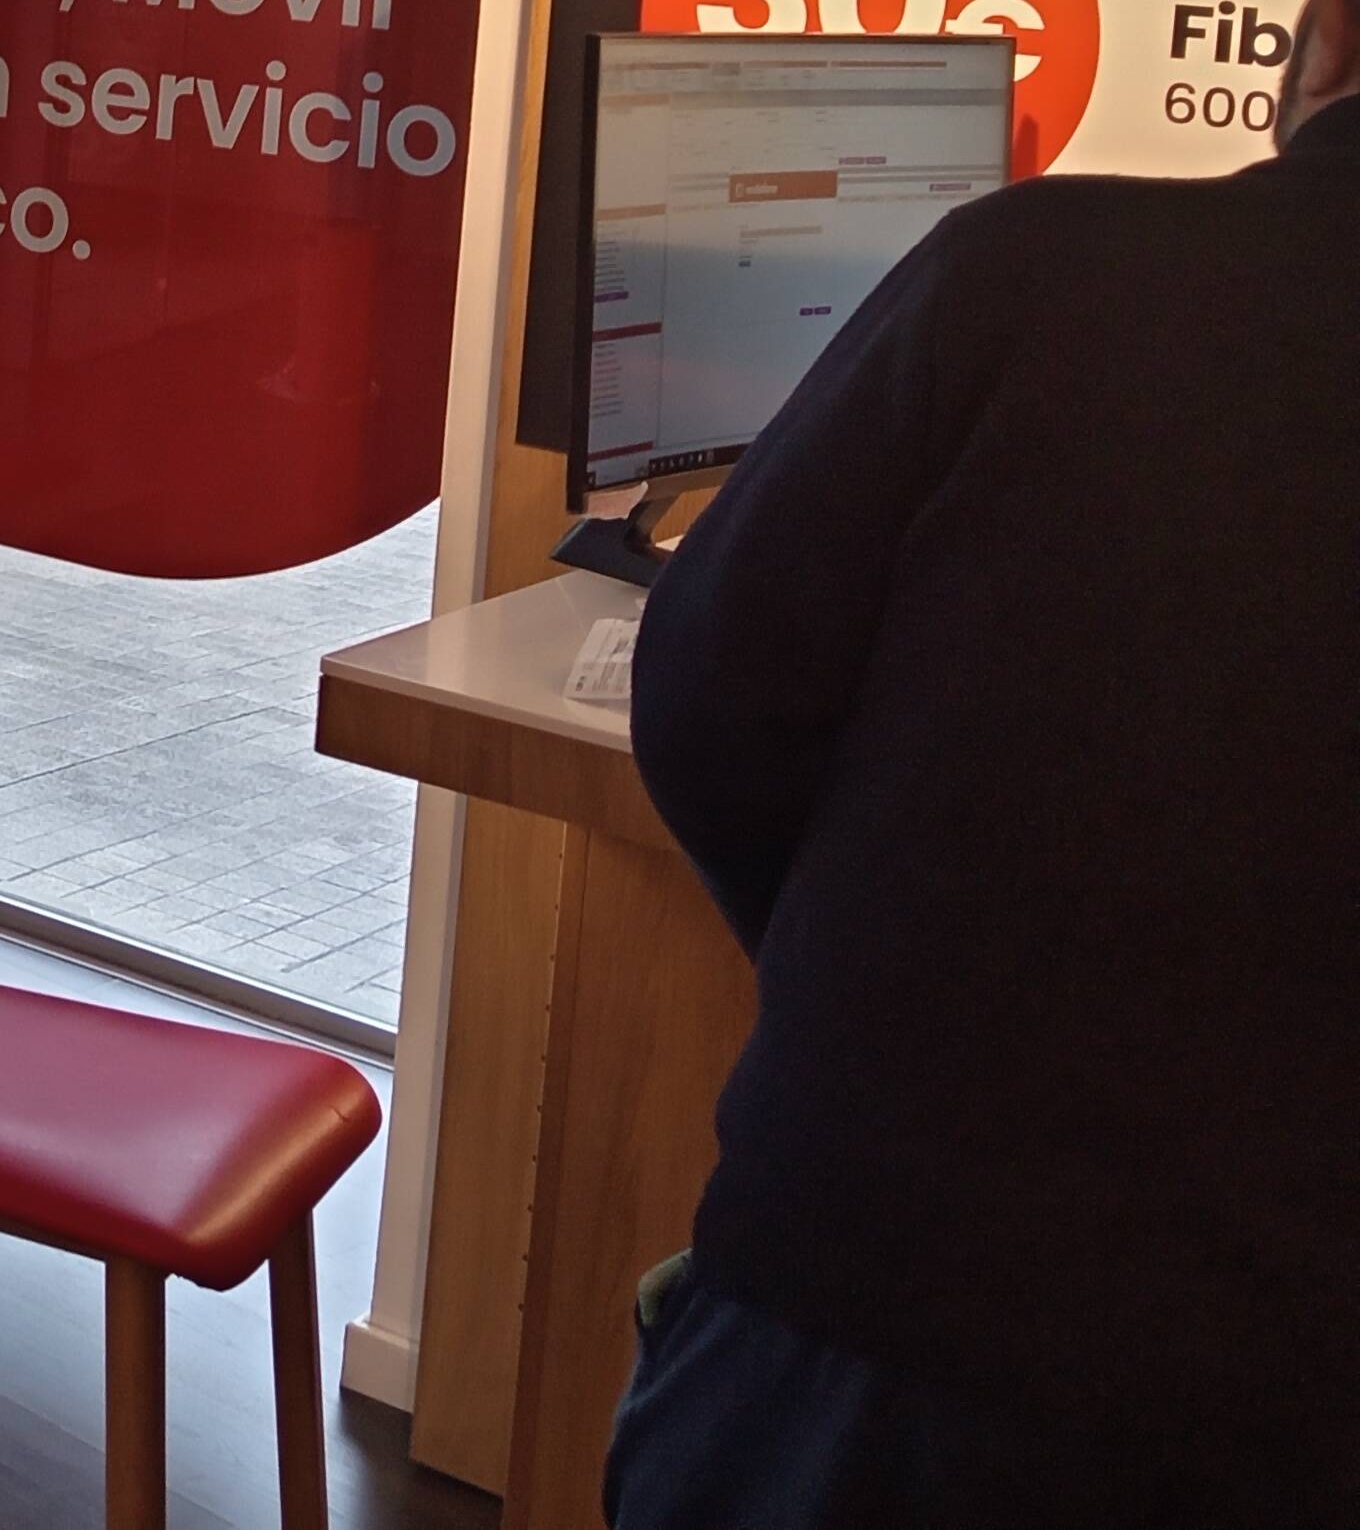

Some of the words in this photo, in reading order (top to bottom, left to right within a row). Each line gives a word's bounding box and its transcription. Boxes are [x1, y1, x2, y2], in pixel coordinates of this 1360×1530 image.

[1170, 0, 1292, 67] Fib
[37, 58, 457, 178] servicio
[1165, 82, 1276, 132] 600
